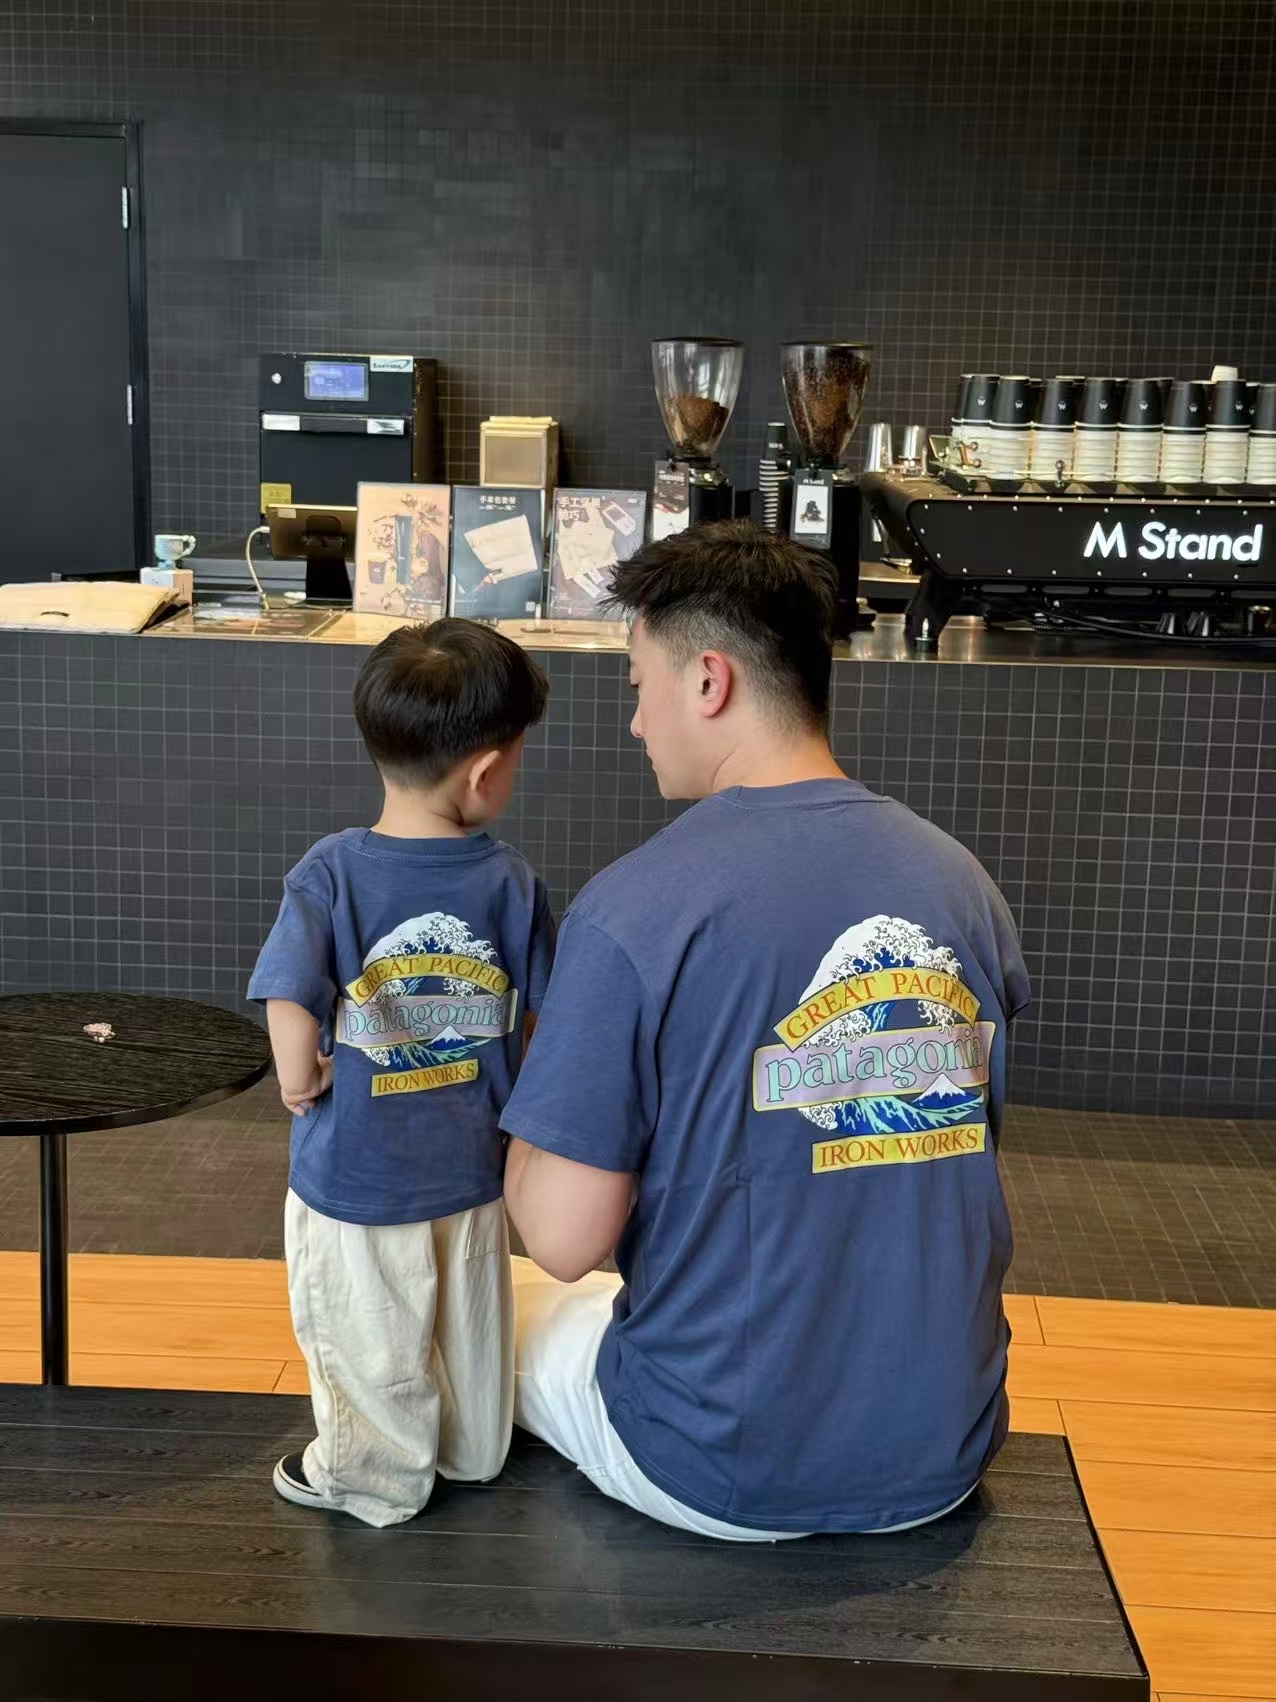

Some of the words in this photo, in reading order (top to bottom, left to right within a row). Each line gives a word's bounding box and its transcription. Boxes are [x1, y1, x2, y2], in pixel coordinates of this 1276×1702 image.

[1083, 521, 1128, 558] M
[1138, 521, 1263, 561] Stand
[355, 957, 419, 997] GREAT
[430, 957, 507, 991] PACIFIC
[344, 999, 505, 1041] patagonia
[786, 976, 876, 1040] GREAT
[891, 973, 976, 1019] PACIFIC
[375, 1074, 422, 1093] IRON
[423, 1062, 475, 1084] WORKS
[766, 1029, 984, 1103] patagonia
[820, 1140, 886, 1168] IRON
[893, 1128, 979, 1158] WORKS
